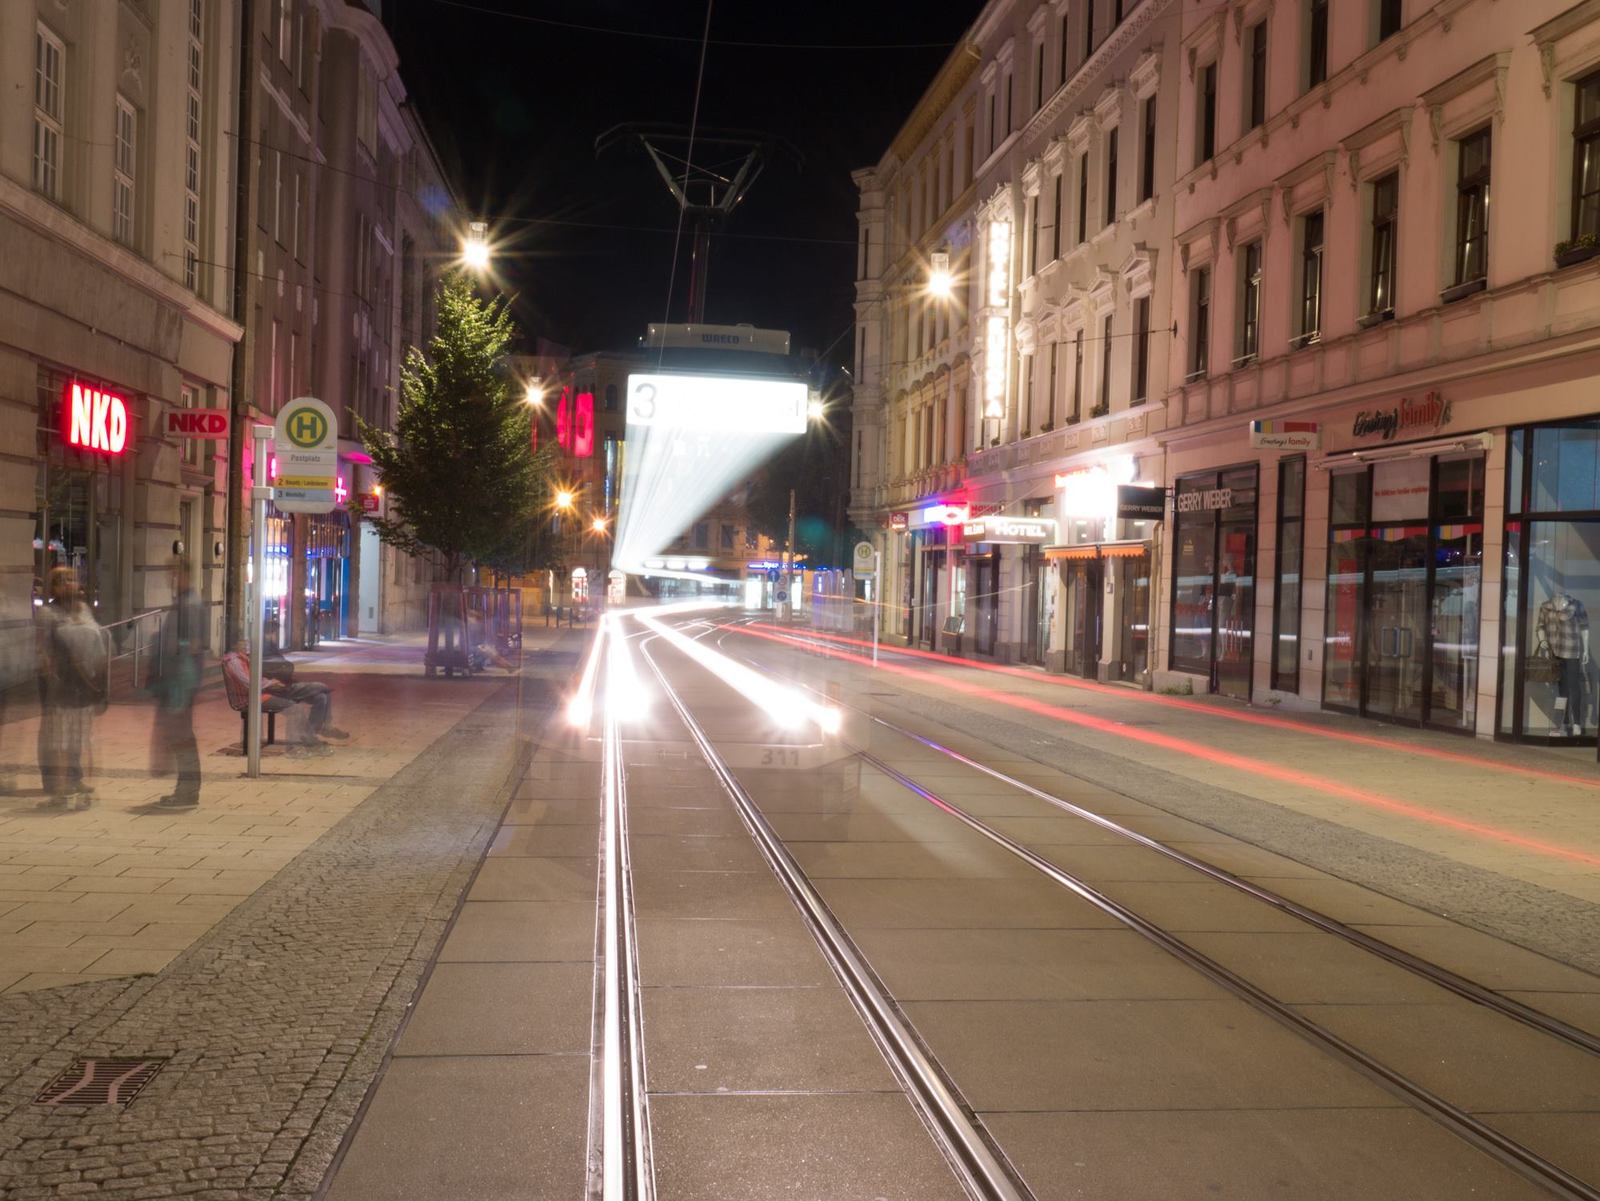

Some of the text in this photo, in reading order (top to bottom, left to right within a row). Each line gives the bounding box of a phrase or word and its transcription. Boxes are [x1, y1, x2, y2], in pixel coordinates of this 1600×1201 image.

[633, 382, 657, 418] 3
[1400, 391, 1444, 428] family
[70, 383, 127, 453] NKD
[168, 413, 227, 433] NKD
[1288, 436, 1312, 447] family
[1178, 487, 1232, 513] GERRY WEBER
[995, 520, 1047, 537] HOTEL
[761, 749, 800, 766] 311
